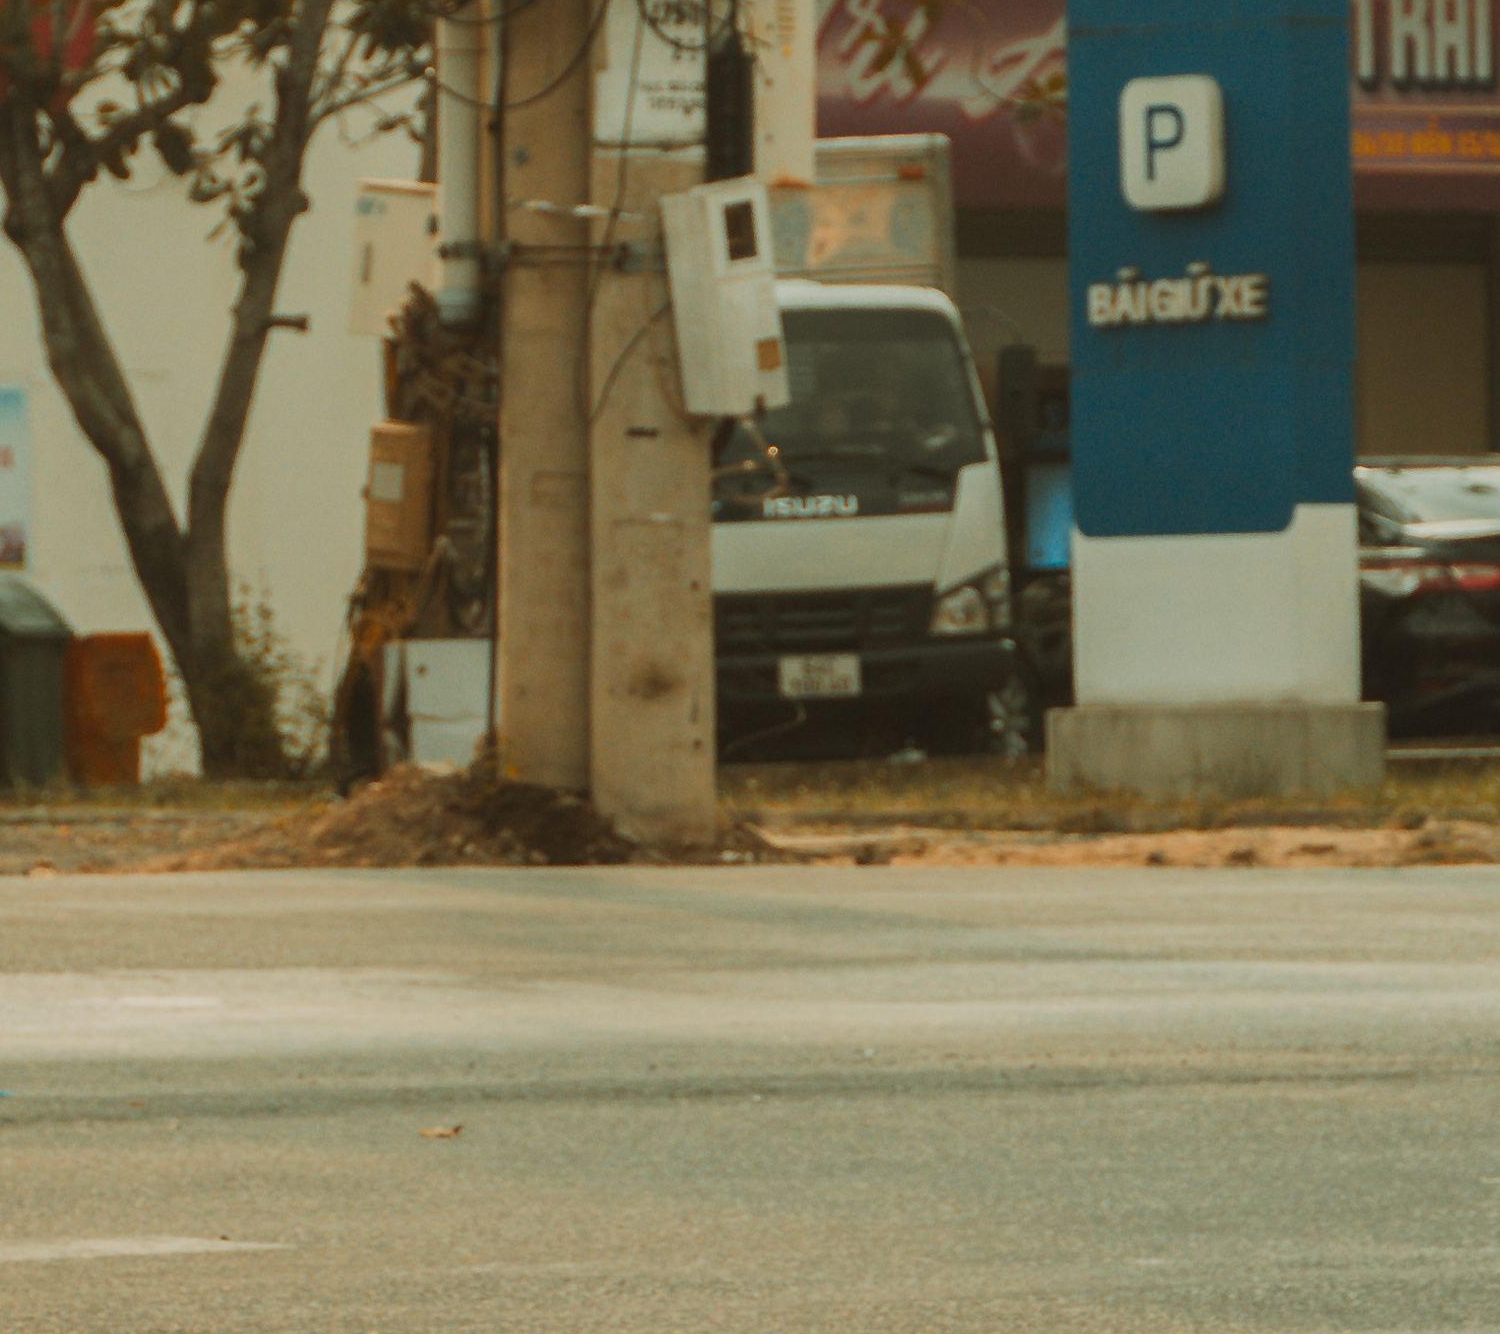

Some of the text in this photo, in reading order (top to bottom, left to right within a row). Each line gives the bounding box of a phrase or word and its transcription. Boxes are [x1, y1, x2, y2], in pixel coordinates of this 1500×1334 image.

[1146, 103, 1185, 182] P
[1215, 273, 1268, 320] XE
[762, 494, 859, 518] ISUZU
